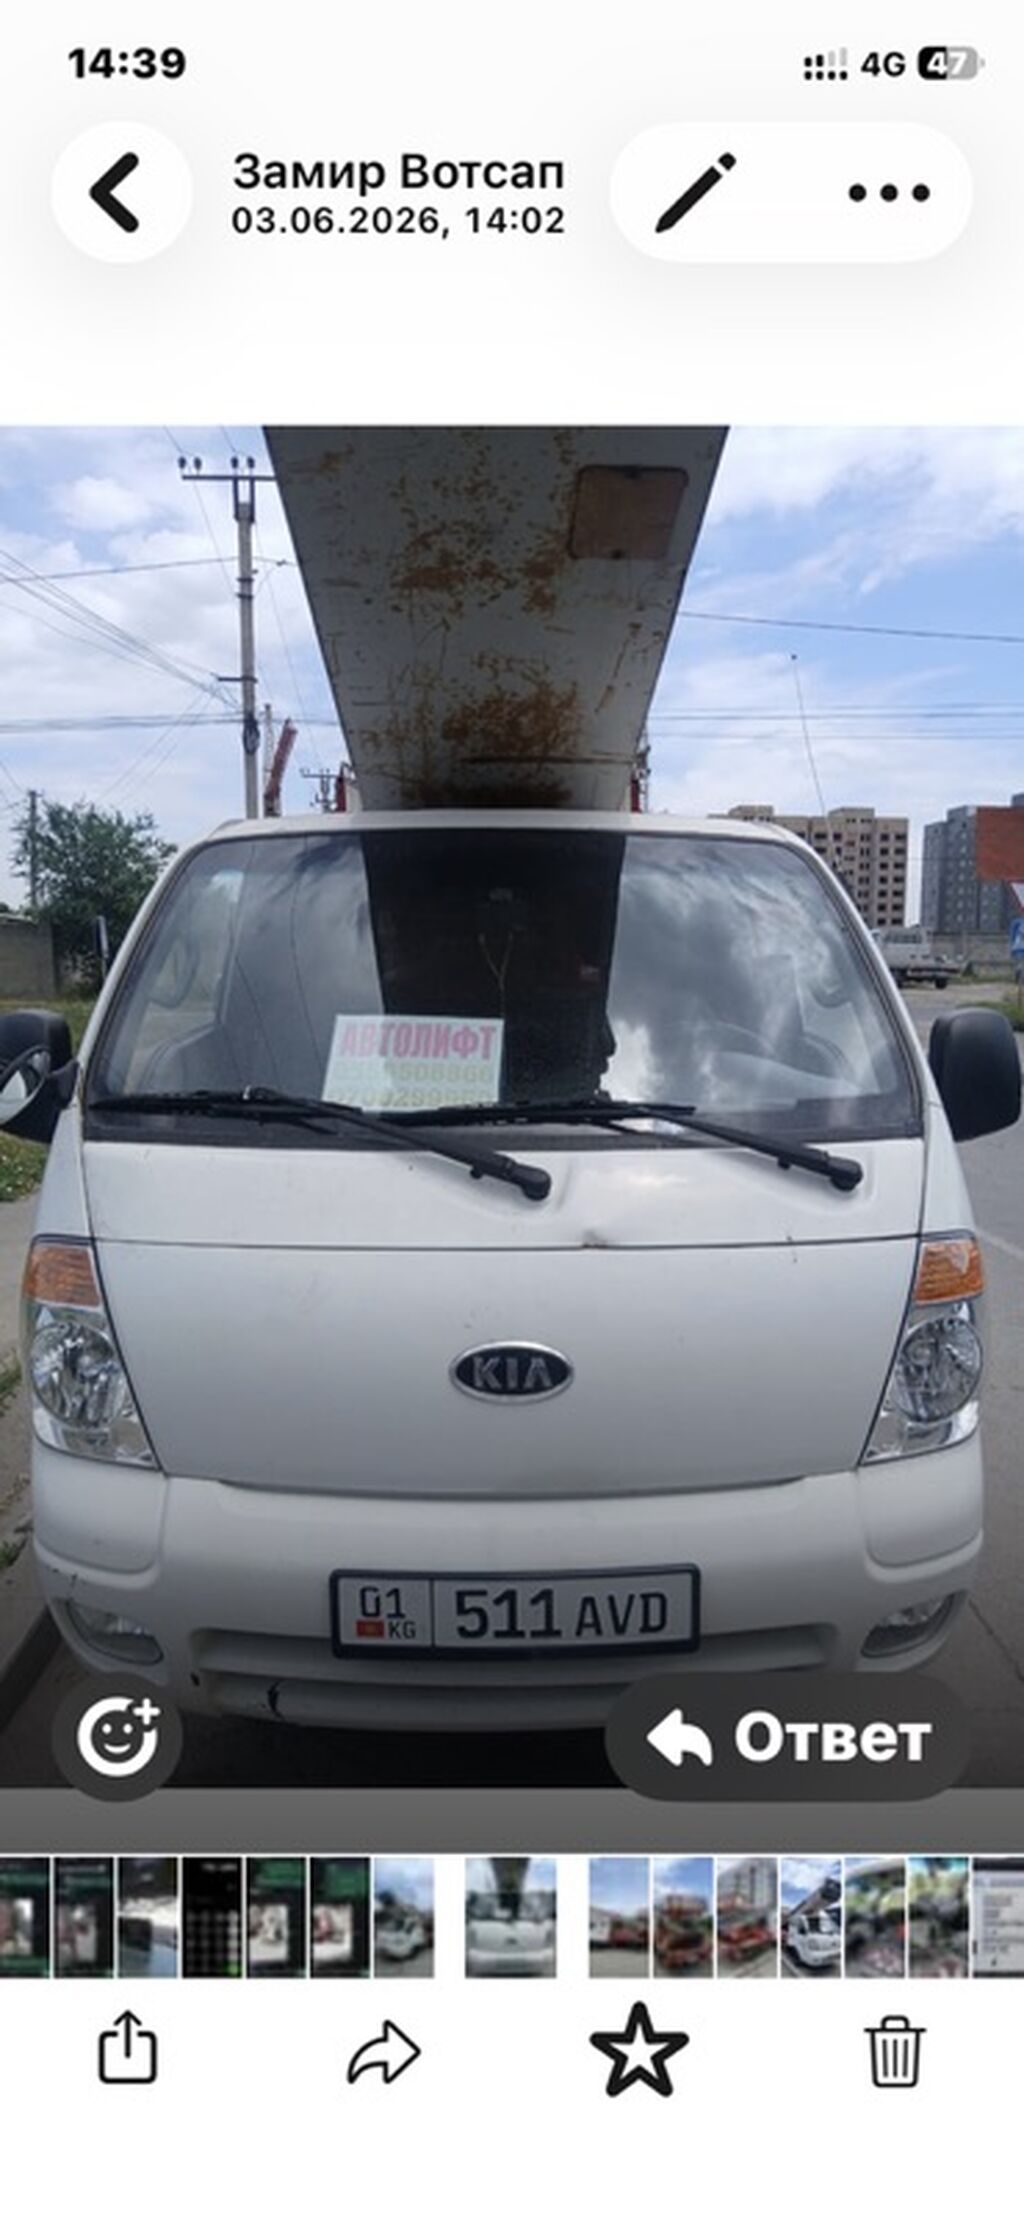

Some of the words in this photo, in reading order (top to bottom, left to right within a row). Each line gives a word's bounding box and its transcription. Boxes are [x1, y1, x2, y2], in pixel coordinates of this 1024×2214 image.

[340, 1022, 496, 1060] АВТОЛИФТ
[471, 1356, 554, 1389] KIA
[358, 1586, 405, 1619] 01
[455, 1589, 562, 1640] 511
[575, 1591, 669, 1637] AVD
[388, 1620, 416, 1639] KG
